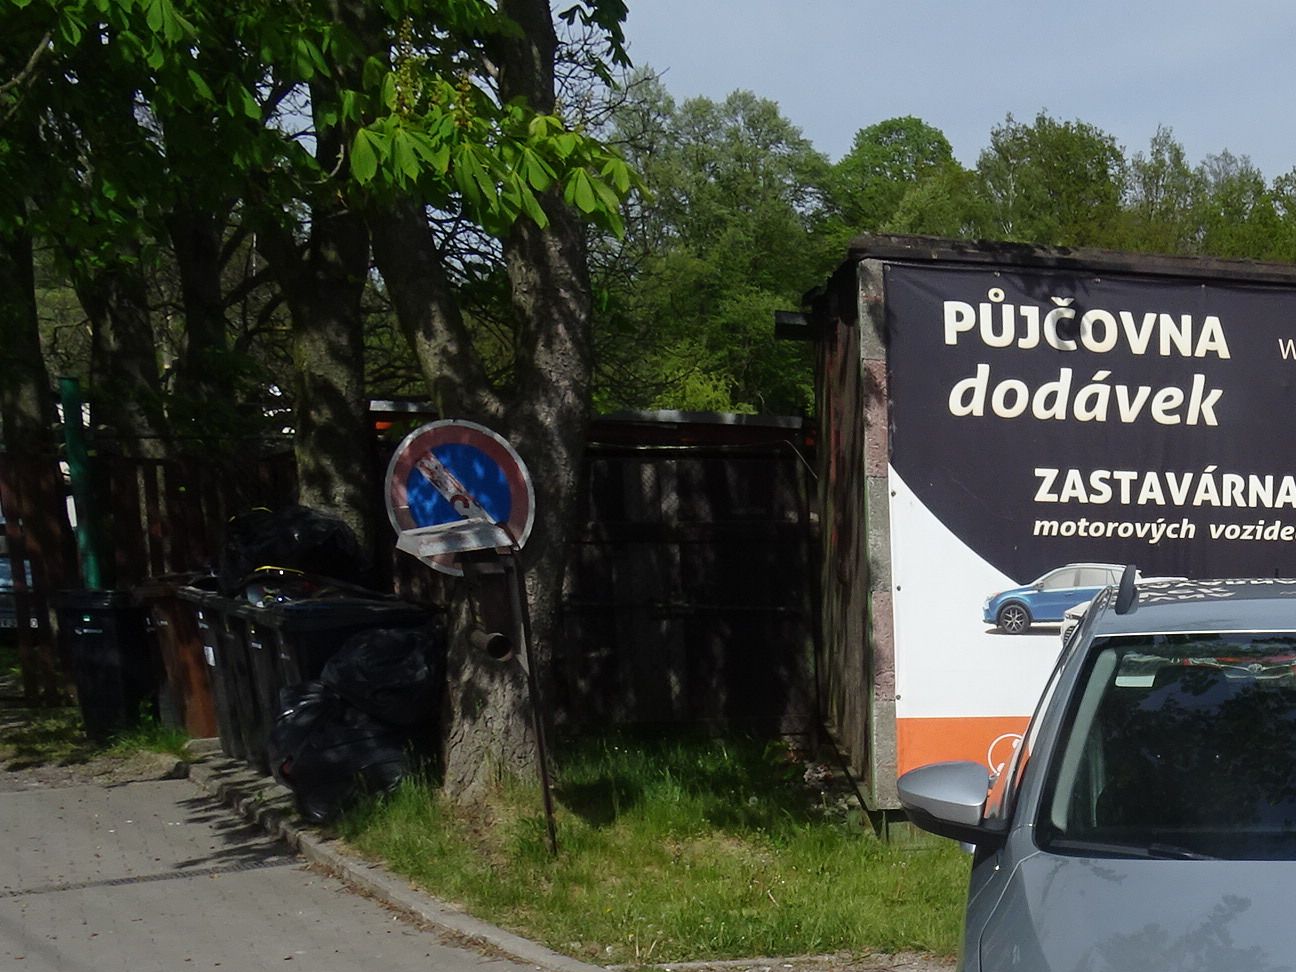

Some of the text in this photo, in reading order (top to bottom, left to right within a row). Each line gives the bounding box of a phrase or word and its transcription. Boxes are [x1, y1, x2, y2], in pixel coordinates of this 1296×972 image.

[944, 287, 1231, 359] PŮJČOVNA
[949, 364, 1224, 426] dodávek
[1033, 517, 1196, 544] motorových
